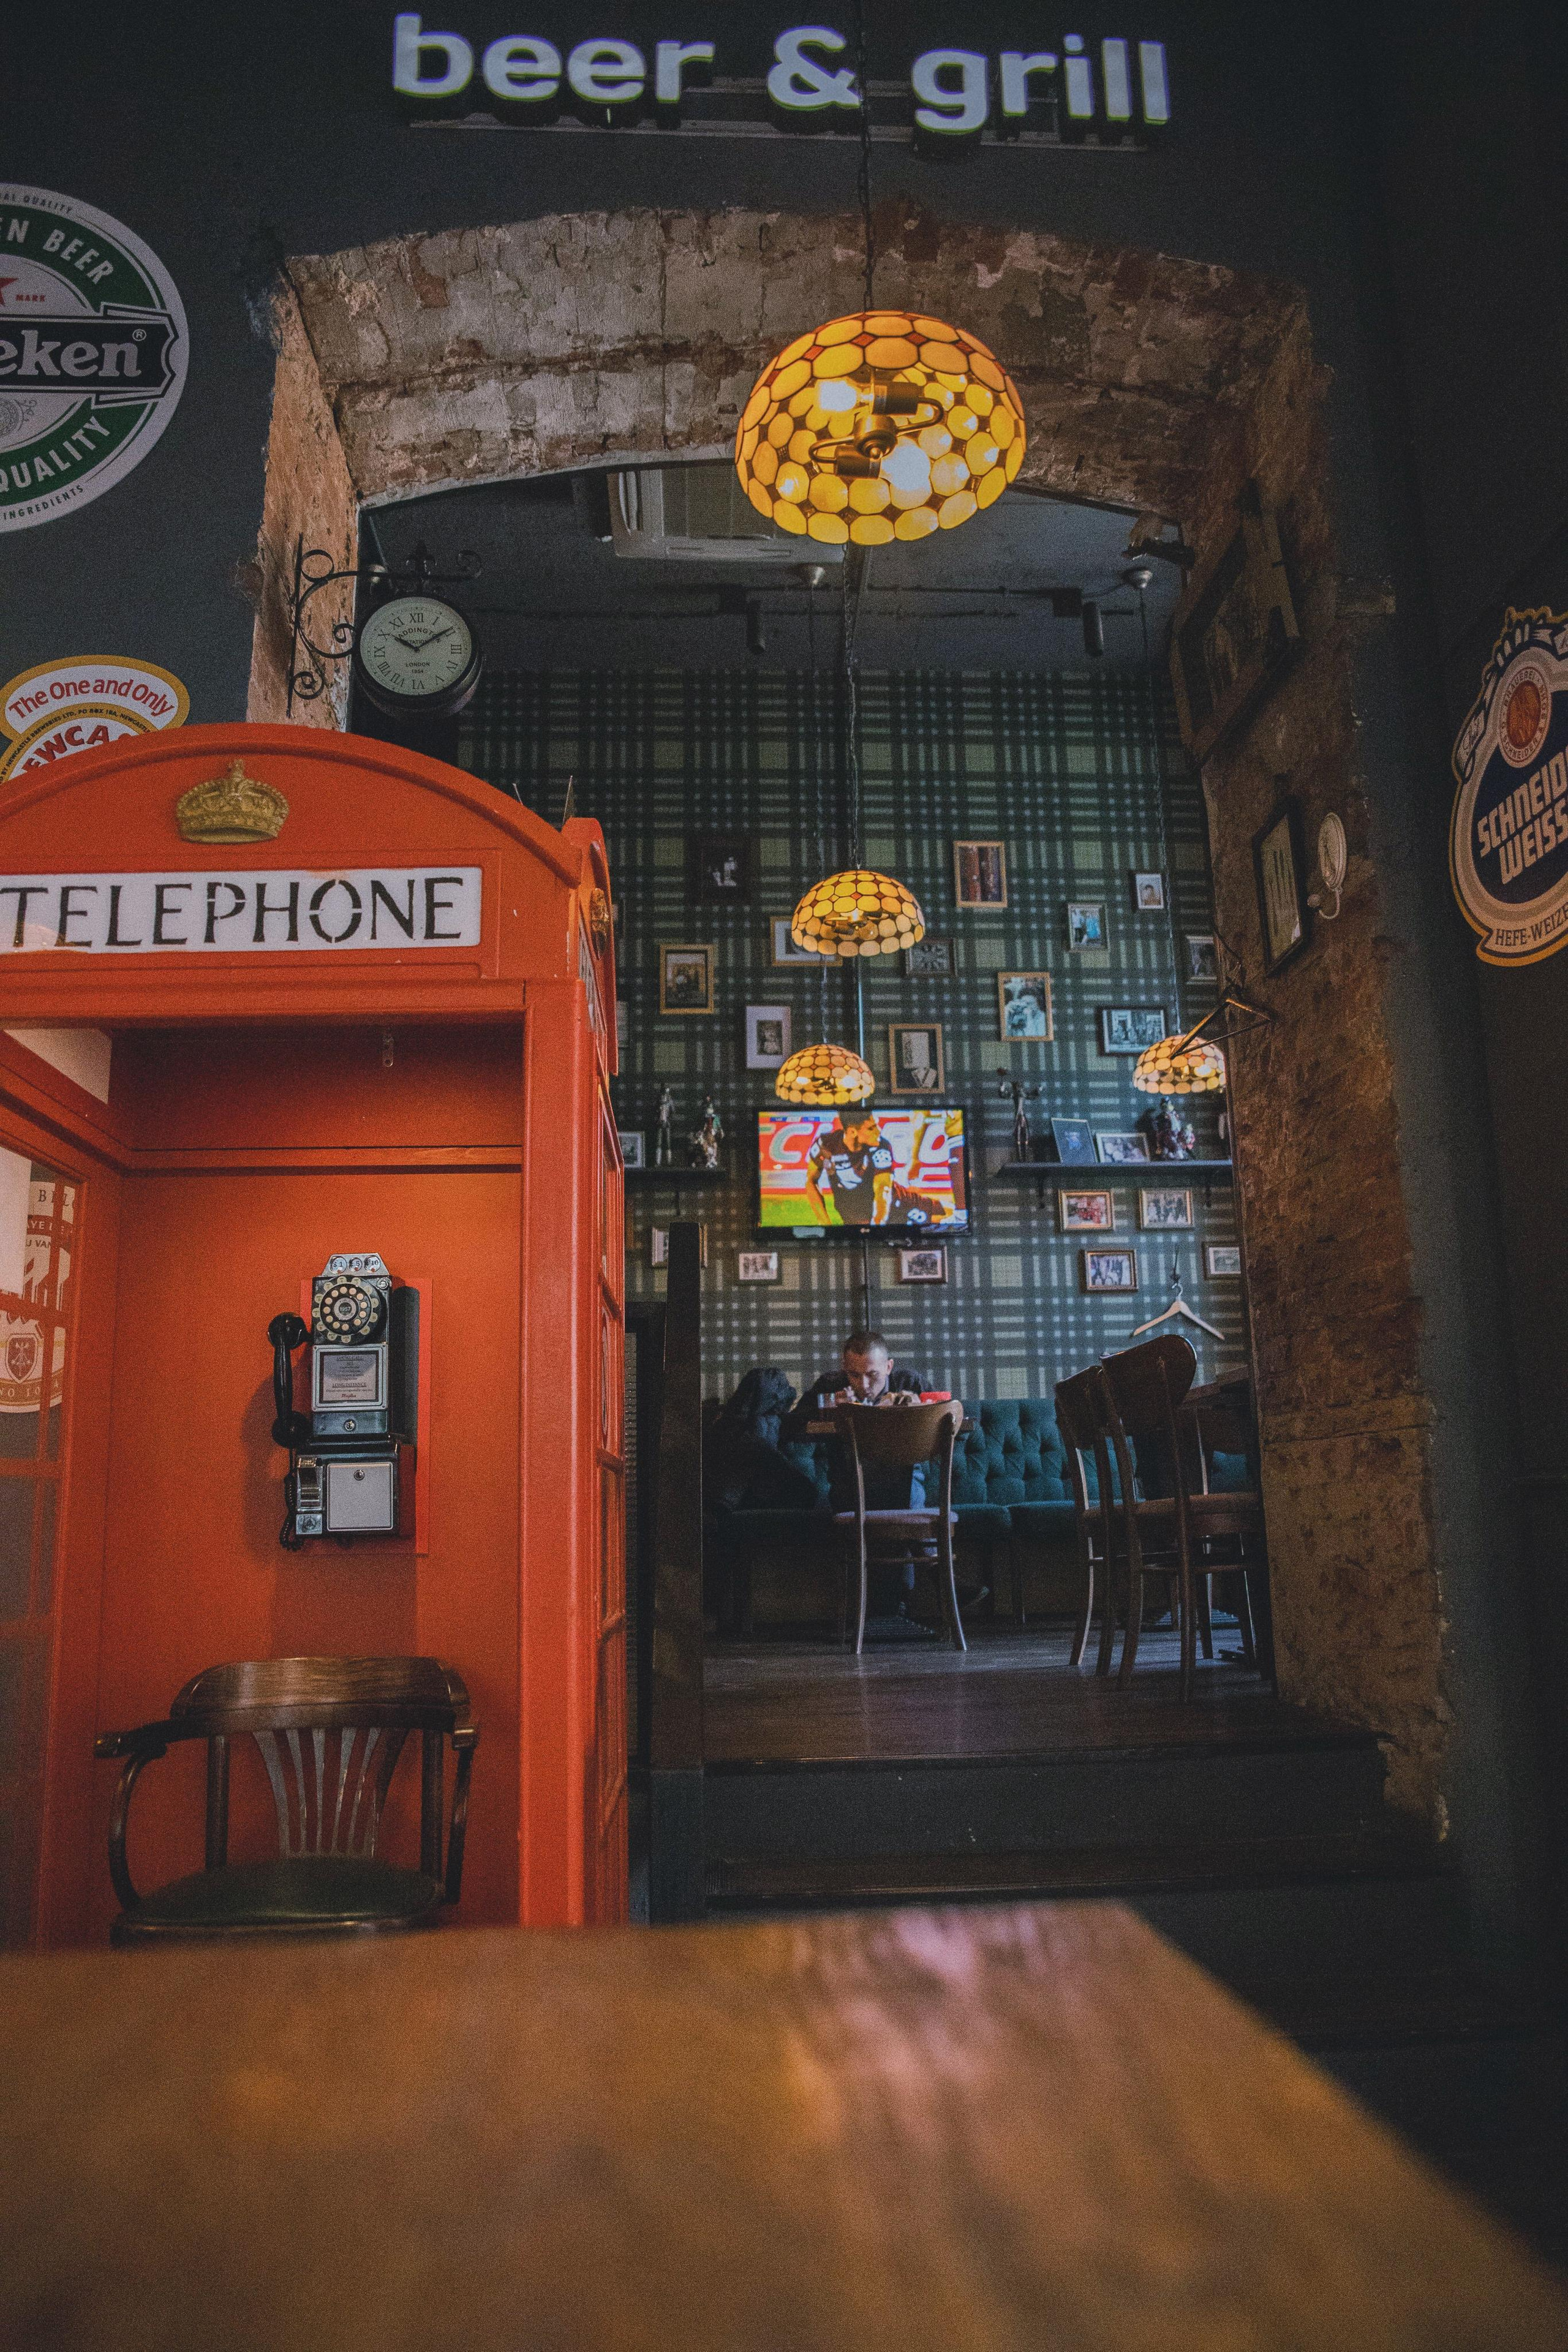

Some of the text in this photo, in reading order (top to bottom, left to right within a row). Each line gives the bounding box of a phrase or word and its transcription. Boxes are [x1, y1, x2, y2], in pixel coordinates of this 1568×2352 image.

[392, 12, 1170, 134] beer & grill
[23, 194, 73, 214] QUALITY
[42, 228, 115, 285] BEER
[3, 484, 84, 520] INGREDIENTS
[8, 678, 175, 719] The One and Only
[1477, 746, 1568, 858] SCHNEID
[1498, 797, 1568, 885] WEISS
[0, 876, 465, 948] TELEPHONE
